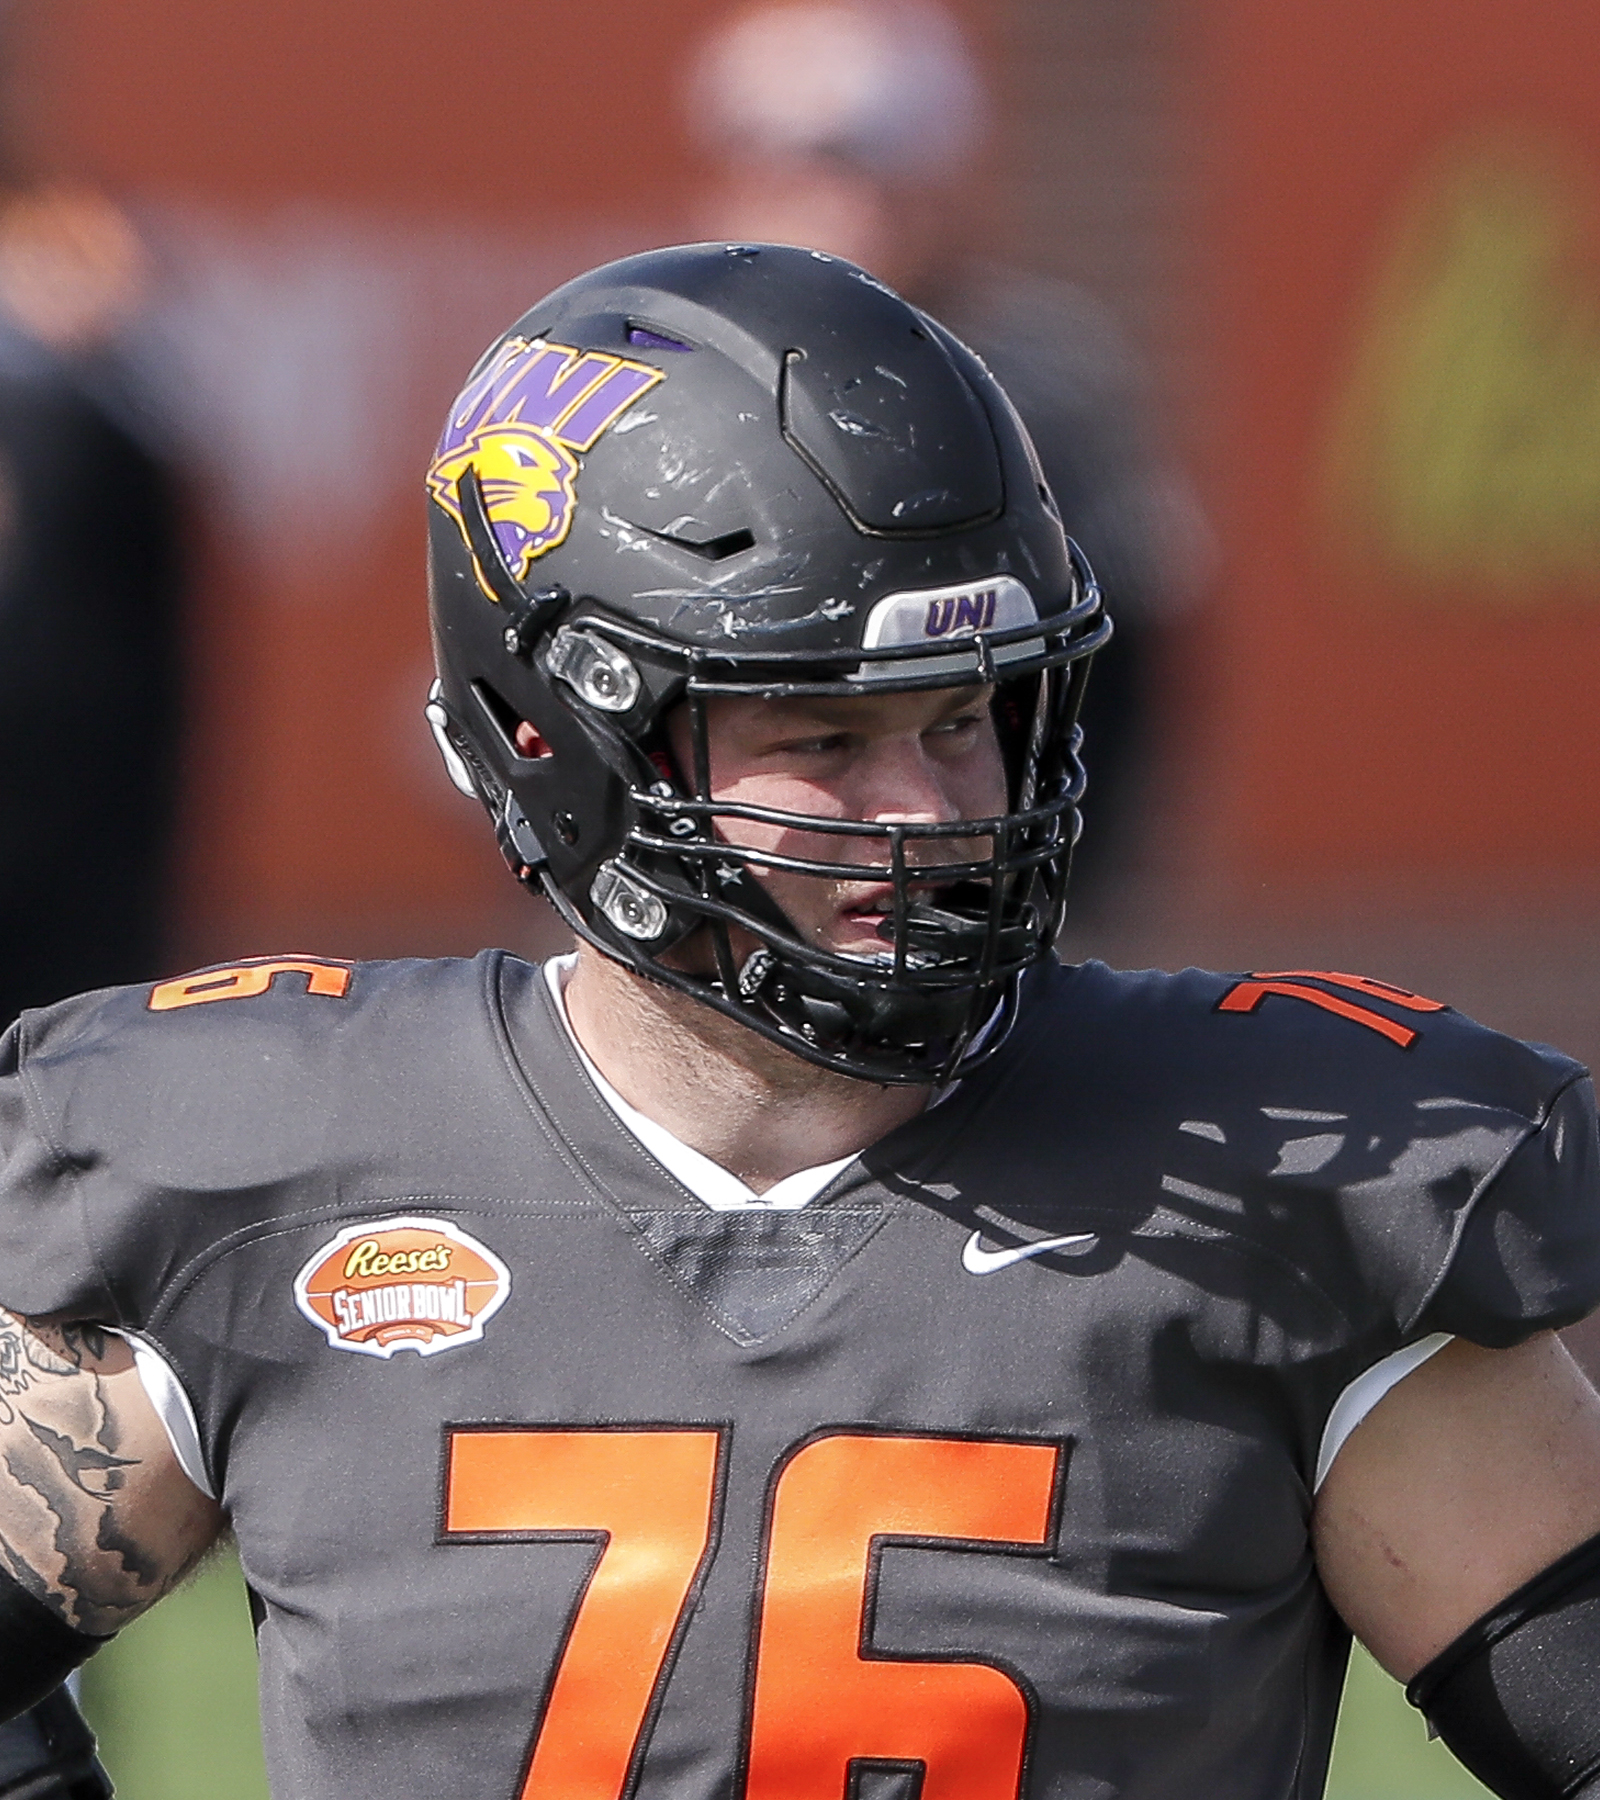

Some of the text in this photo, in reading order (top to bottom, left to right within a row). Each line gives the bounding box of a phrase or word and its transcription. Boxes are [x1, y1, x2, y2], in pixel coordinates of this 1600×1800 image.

[436, 340, 668, 453] UNI
[924, 589, 998, 638] UNI
[344, 1238, 454, 1279] Reese's
[332, 1278, 473, 1339] SENIOR BOWL
